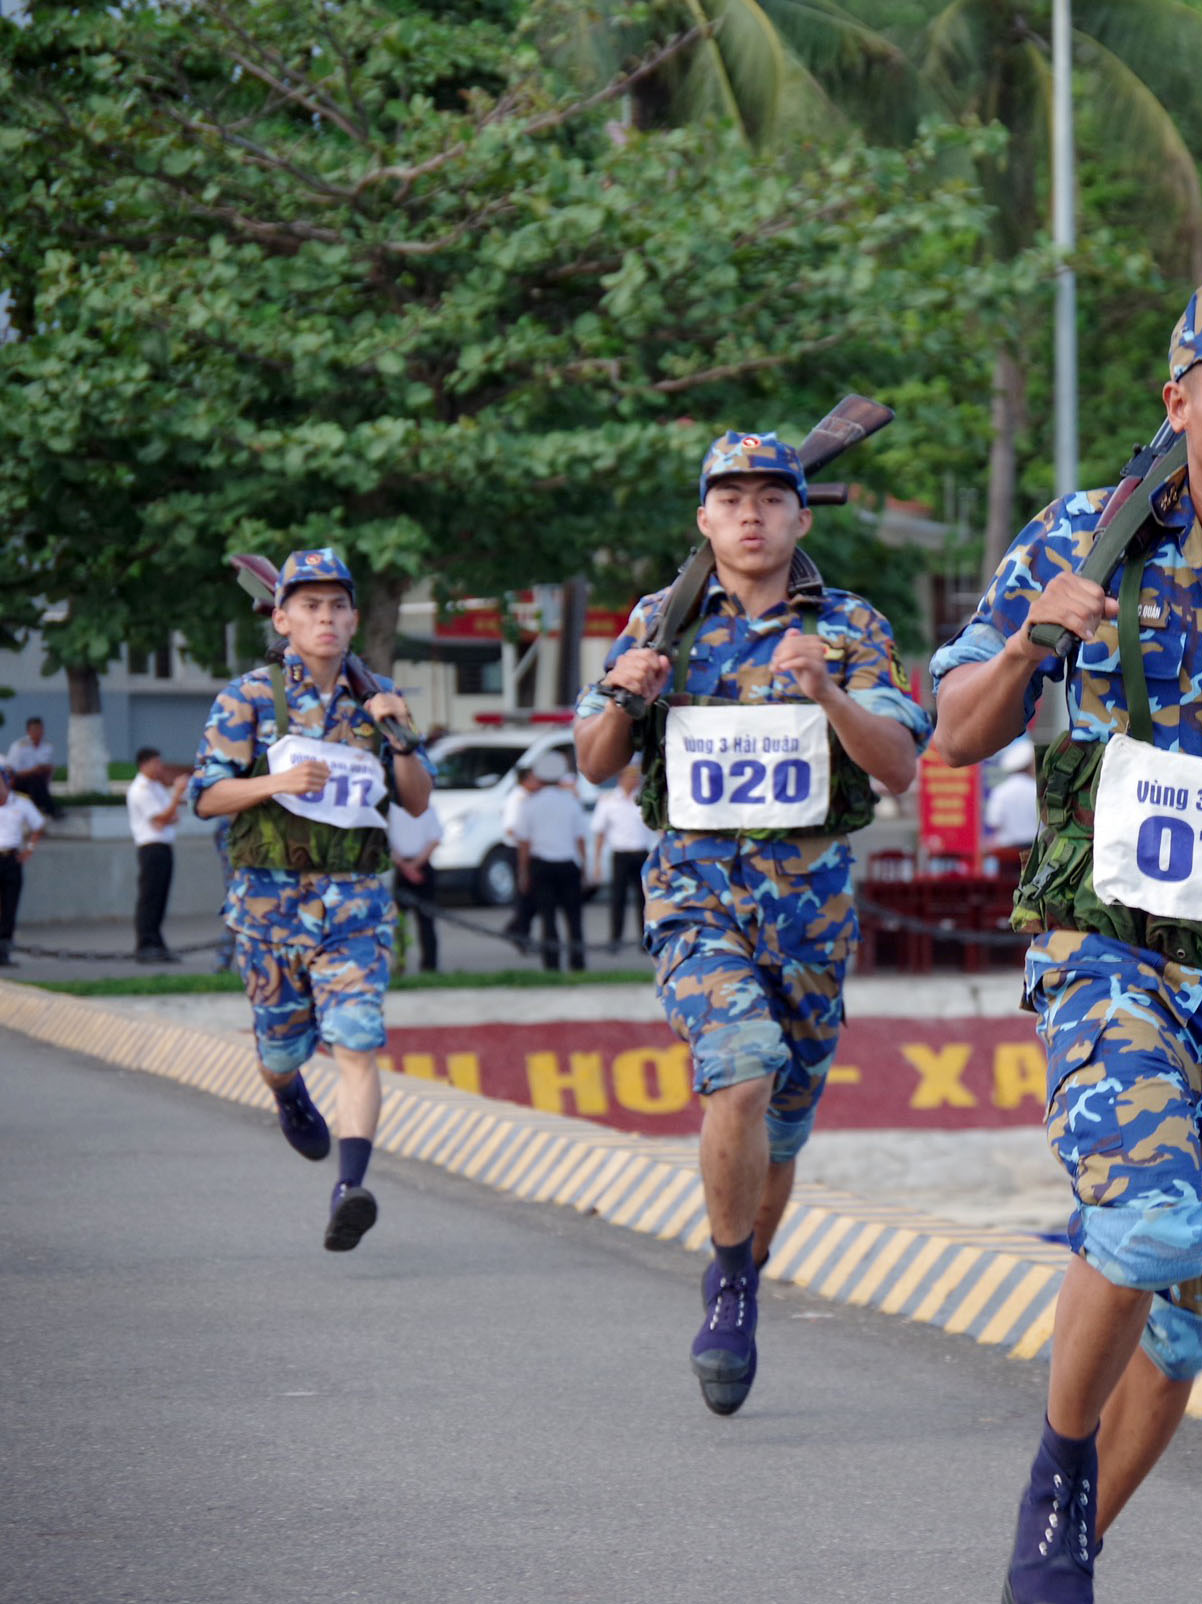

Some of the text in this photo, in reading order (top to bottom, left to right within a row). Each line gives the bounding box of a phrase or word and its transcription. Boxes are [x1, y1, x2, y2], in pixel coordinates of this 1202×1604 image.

[719, 737, 729, 753] 3
[733, 734, 757, 753] Hải
[691, 758, 811, 805] 020
[1136, 780, 1189, 811] Vùng
